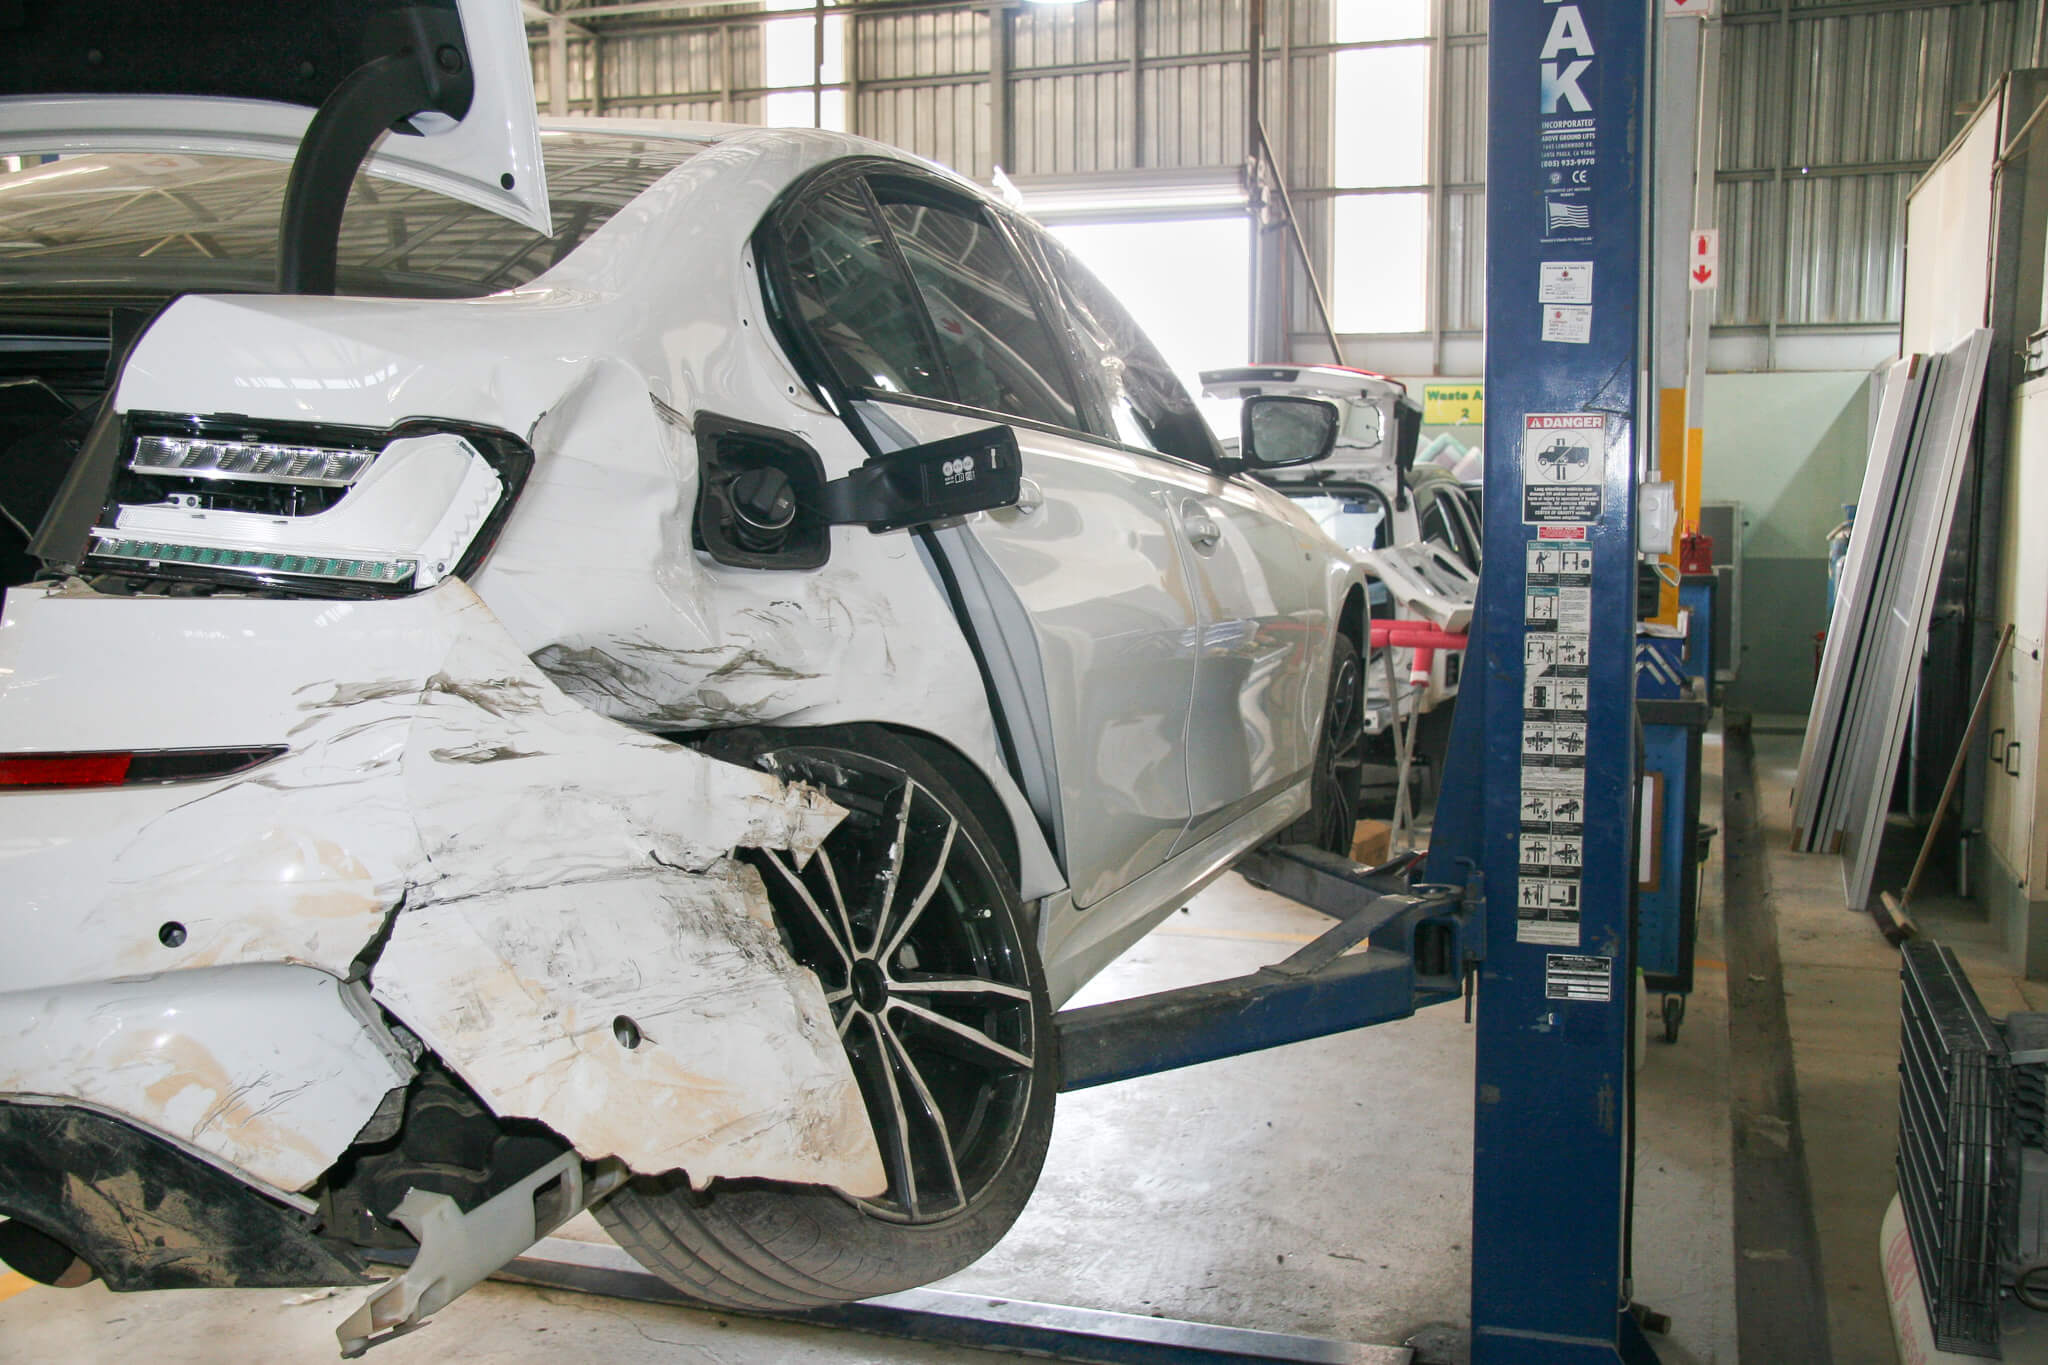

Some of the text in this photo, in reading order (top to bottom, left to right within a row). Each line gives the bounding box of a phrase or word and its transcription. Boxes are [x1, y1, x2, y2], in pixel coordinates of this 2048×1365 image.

[1539, 0, 1595, 114] AK
[1541, 119, 1593, 129] INCORPORATED
[1572, 170, 1587, 184] CE
[1427, 390, 1469, 401] Waste
[1544, 416, 1602, 428] DANGER
